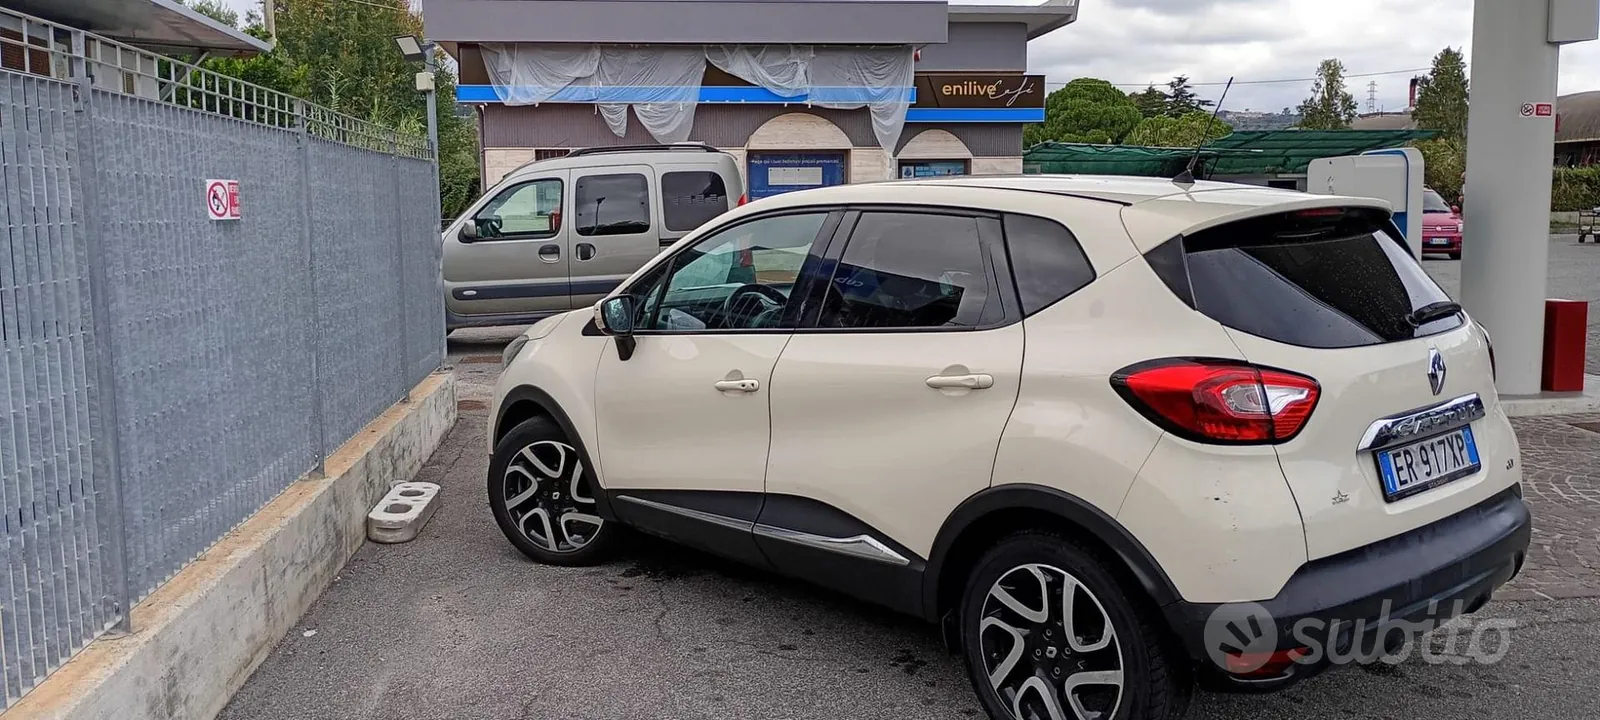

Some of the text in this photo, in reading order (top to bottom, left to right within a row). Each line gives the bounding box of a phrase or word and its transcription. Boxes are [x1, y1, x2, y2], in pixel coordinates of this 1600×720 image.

[942, 76, 1034, 107] enilive Café
[1392, 449, 1418, 486] ER
[1420, 433, 1465, 477] 917XP
